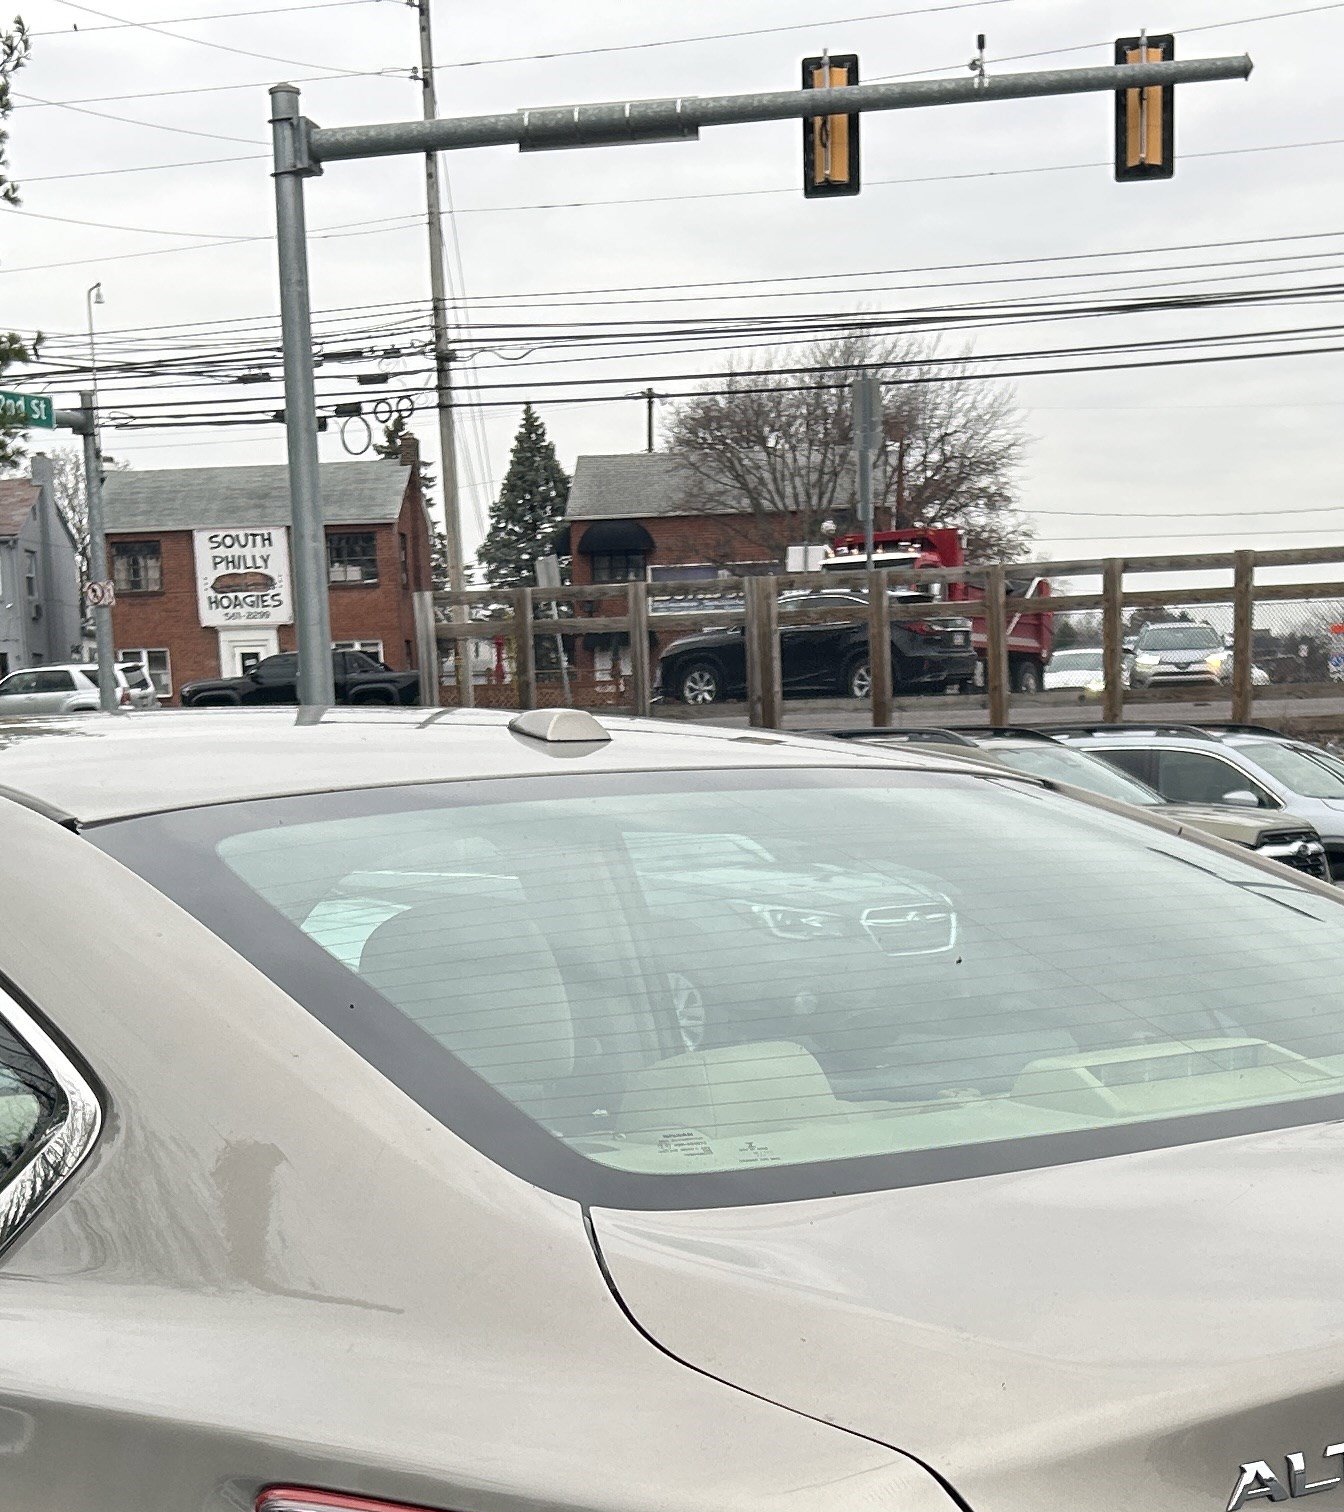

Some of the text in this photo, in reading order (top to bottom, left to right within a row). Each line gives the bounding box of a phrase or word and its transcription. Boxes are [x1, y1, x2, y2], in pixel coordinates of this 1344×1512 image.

[30, 399, 47, 420] St
[208, 532, 273, 550] SOUTH
[212, 554, 271, 570] PHILLY
[208, 593, 283, 610] HOAGIES
